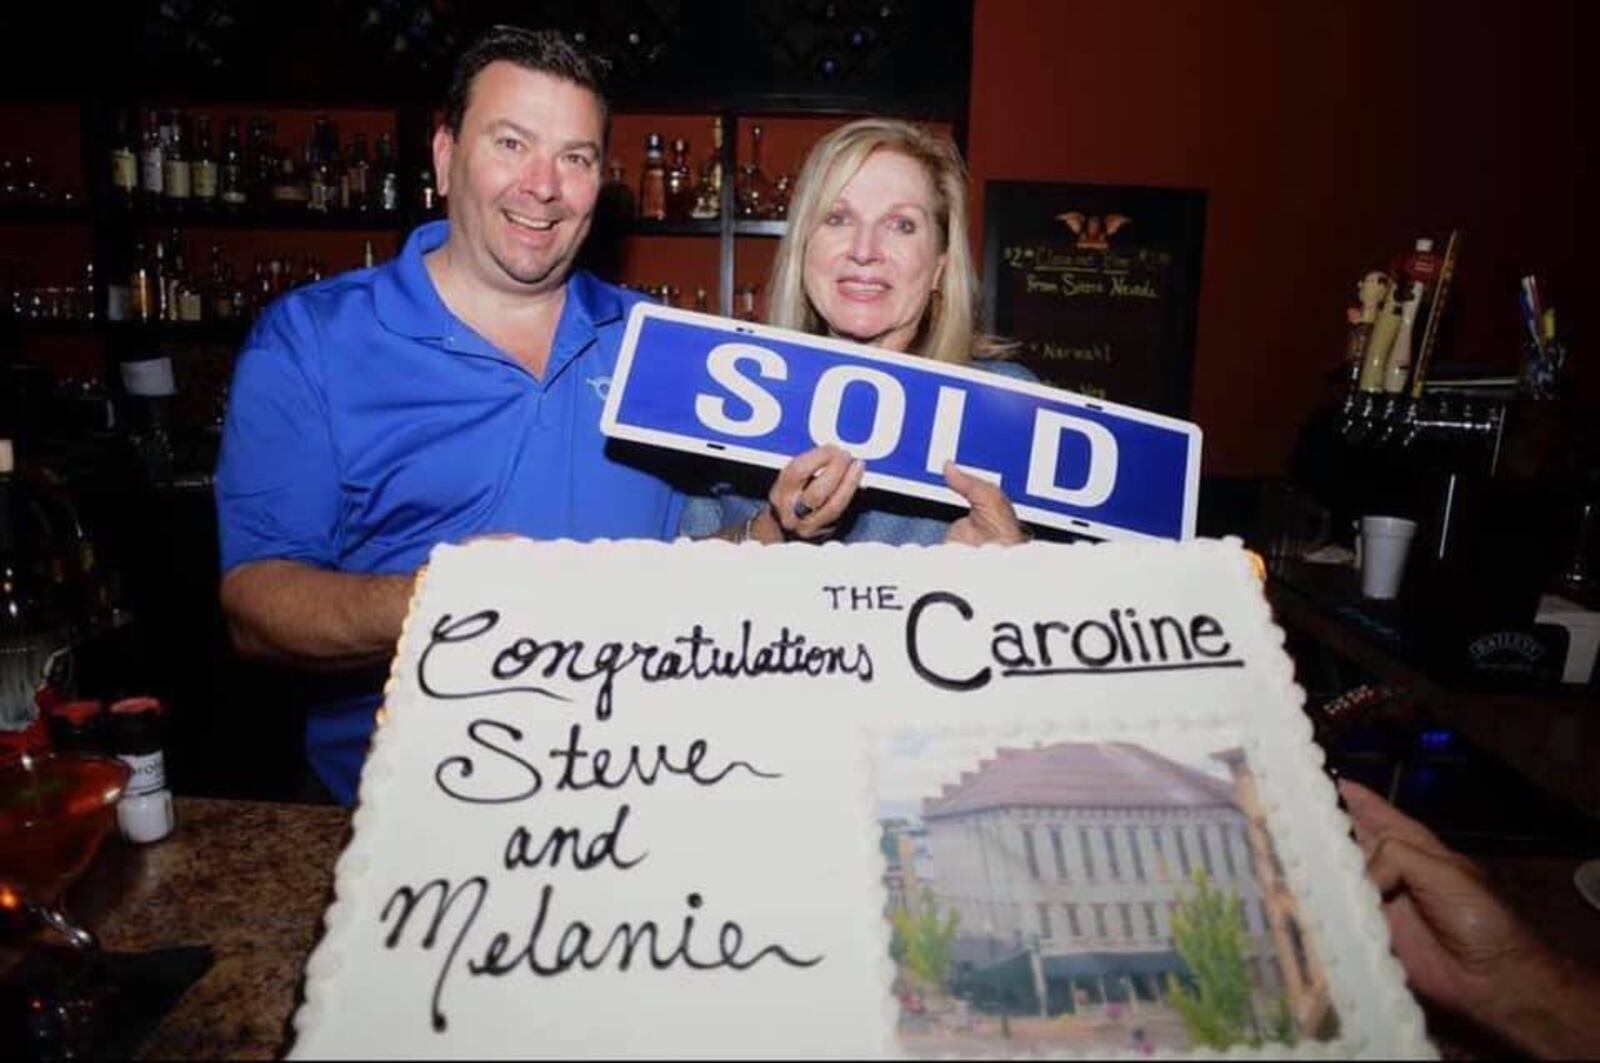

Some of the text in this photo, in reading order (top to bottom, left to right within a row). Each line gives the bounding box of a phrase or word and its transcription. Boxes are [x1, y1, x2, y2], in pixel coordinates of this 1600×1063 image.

[695, 342, 1119, 508] SOLD
[418, 609, 874, 721] Congratulations
[823, 586, 1231, 692] THE Caroline
[435, 719, 783, 804] Steve
[504, 804, 649, 870] and
[380, 876, 824, 1033] Melanie
